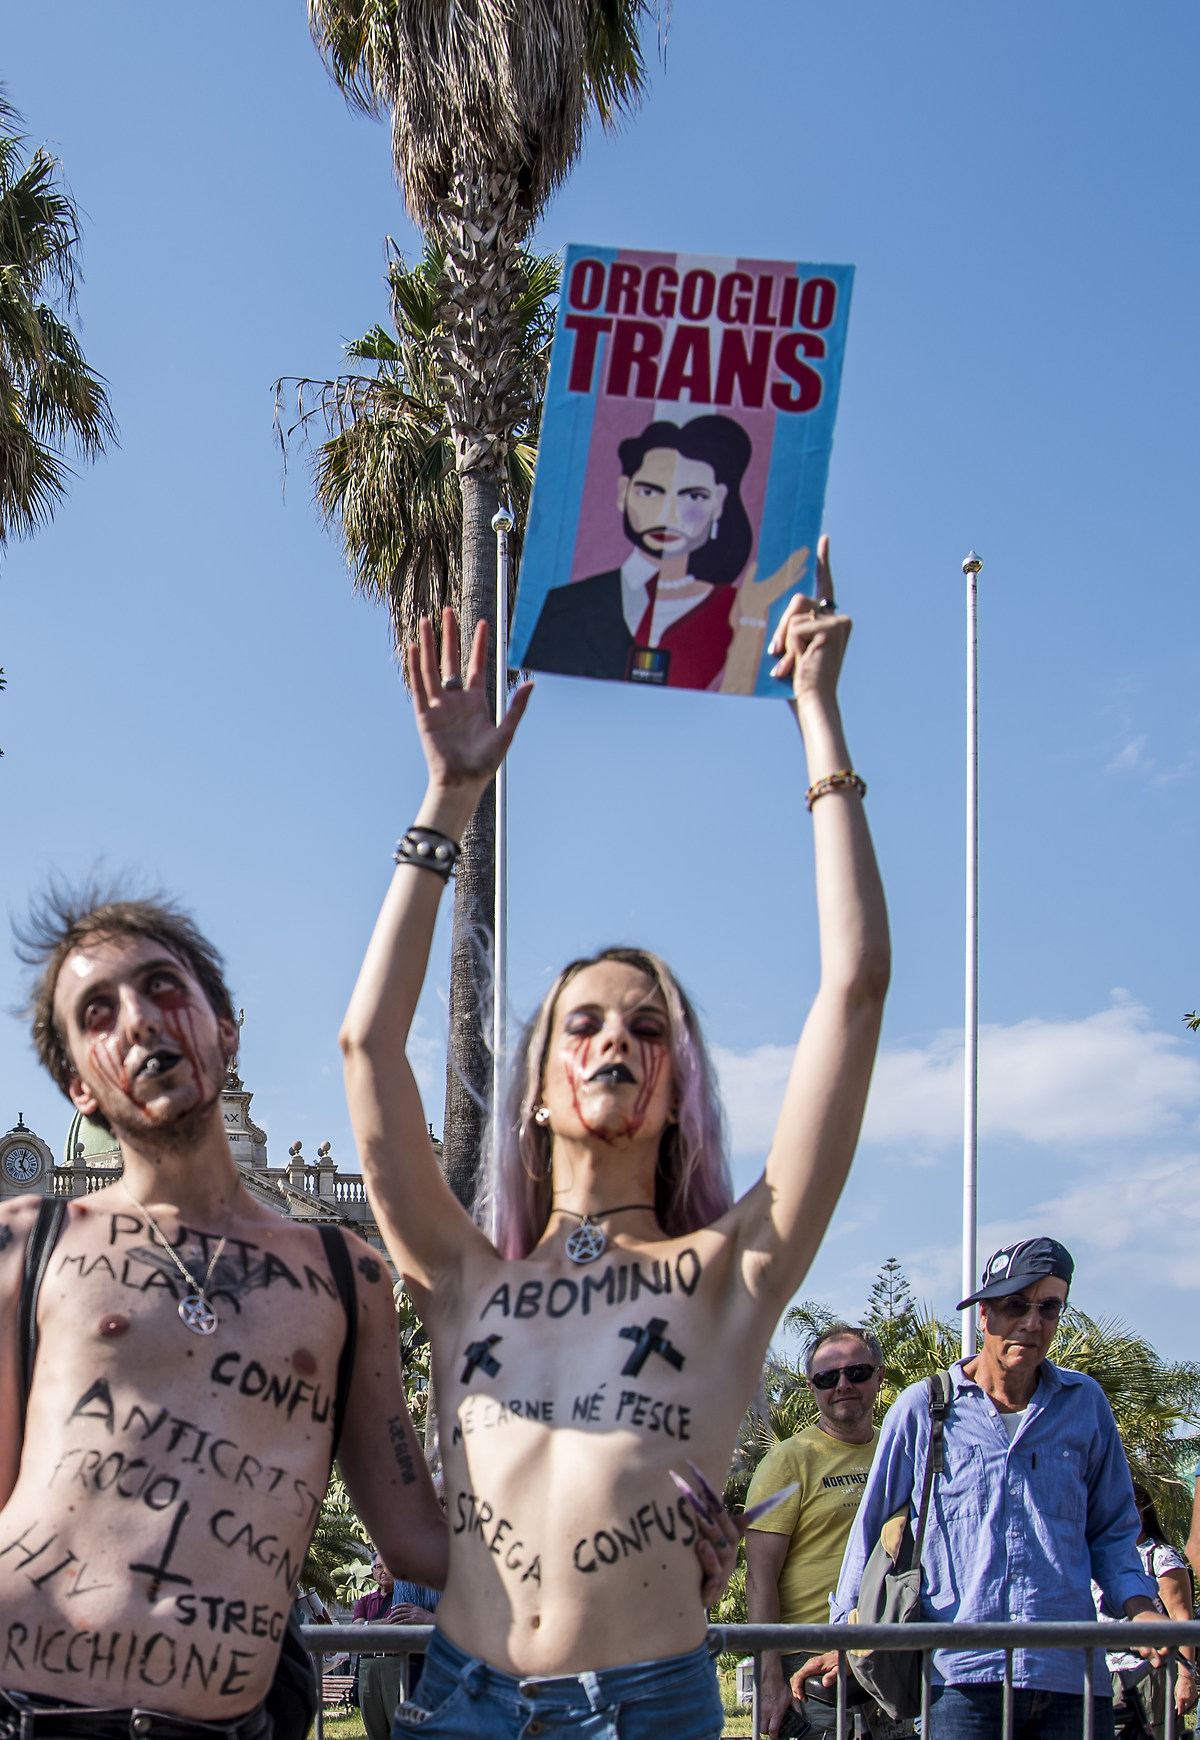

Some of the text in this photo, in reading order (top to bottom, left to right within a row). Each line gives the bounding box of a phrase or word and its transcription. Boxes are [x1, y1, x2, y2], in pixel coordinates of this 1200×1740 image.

[568, 258, 837, 331] ORGOGLIO
[563, 315, 826, 413] TRANS
[480, 1247, 701, 1321] ABOMINIO
[571, 1383, 605, 1424] NÉ
[615, 1389, 691, 1441] PESCE
[48, 1448, 181, 1511] FROCIO
[822, 1472, 869, 1489] NORTHER
[453, 1490, 542, 1588] STREGA
[573, 1496, 697, 1573] CONFUS
[174, 1594, 284, 1643] STREG
[2, 1622, 257, 1696] RICCHIONE
